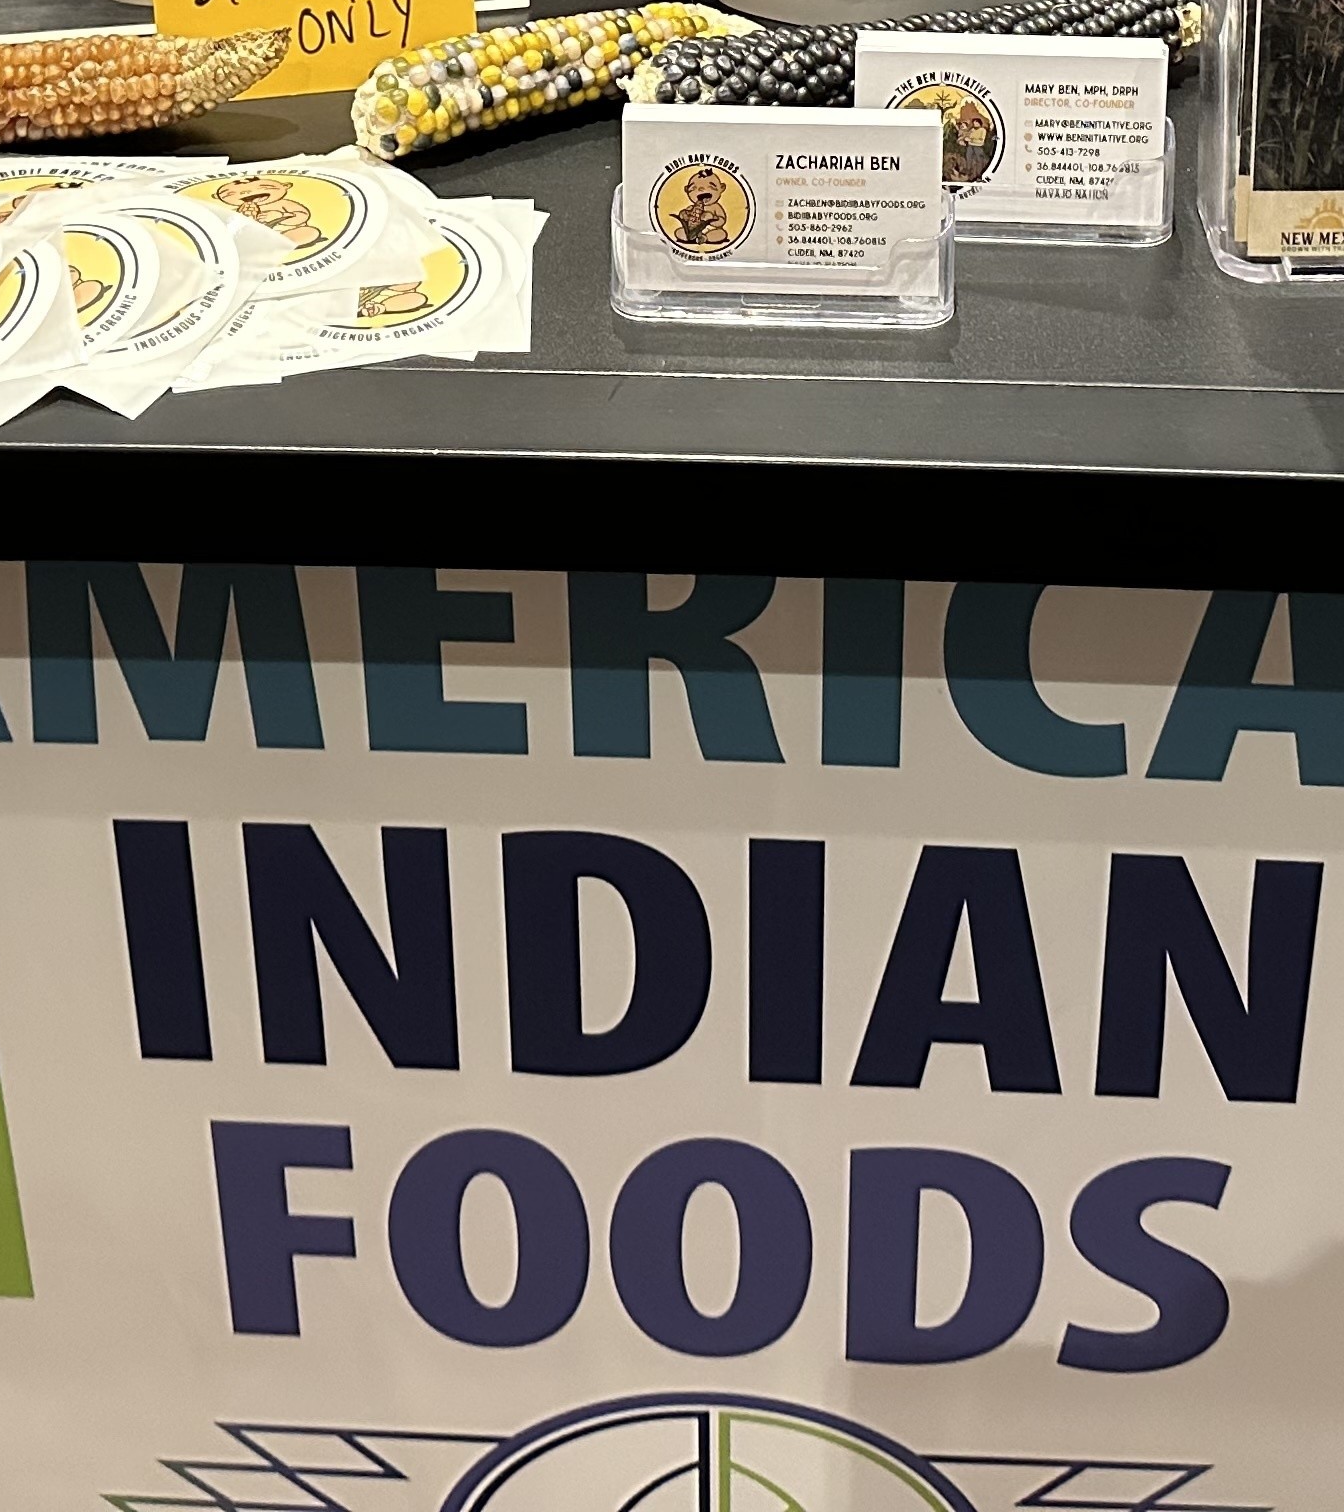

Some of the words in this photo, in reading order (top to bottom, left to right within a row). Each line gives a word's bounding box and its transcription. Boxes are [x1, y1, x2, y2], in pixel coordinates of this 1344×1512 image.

[895, 79, 914, 95] THE
[916, 72, 936, 85] BEN
[1025, 84, 1054, 94] MARY
[1058, 85, 1080, 96] BEN,
[1084, 85, 1108, 96] MPH,
[1112, 86, 1138, 96] DRPH
[1076, 99, 1134, 108] CO-FOUNDER
[776, 155, 864, 170] ZACHARIAH
[871, 157, 900, 170] BEN
[1281, 232, 1314, 246] NEW
[111, 818, 1323, 1103] INDIAN
[209, 1119, 1234, 1375] FOODS
